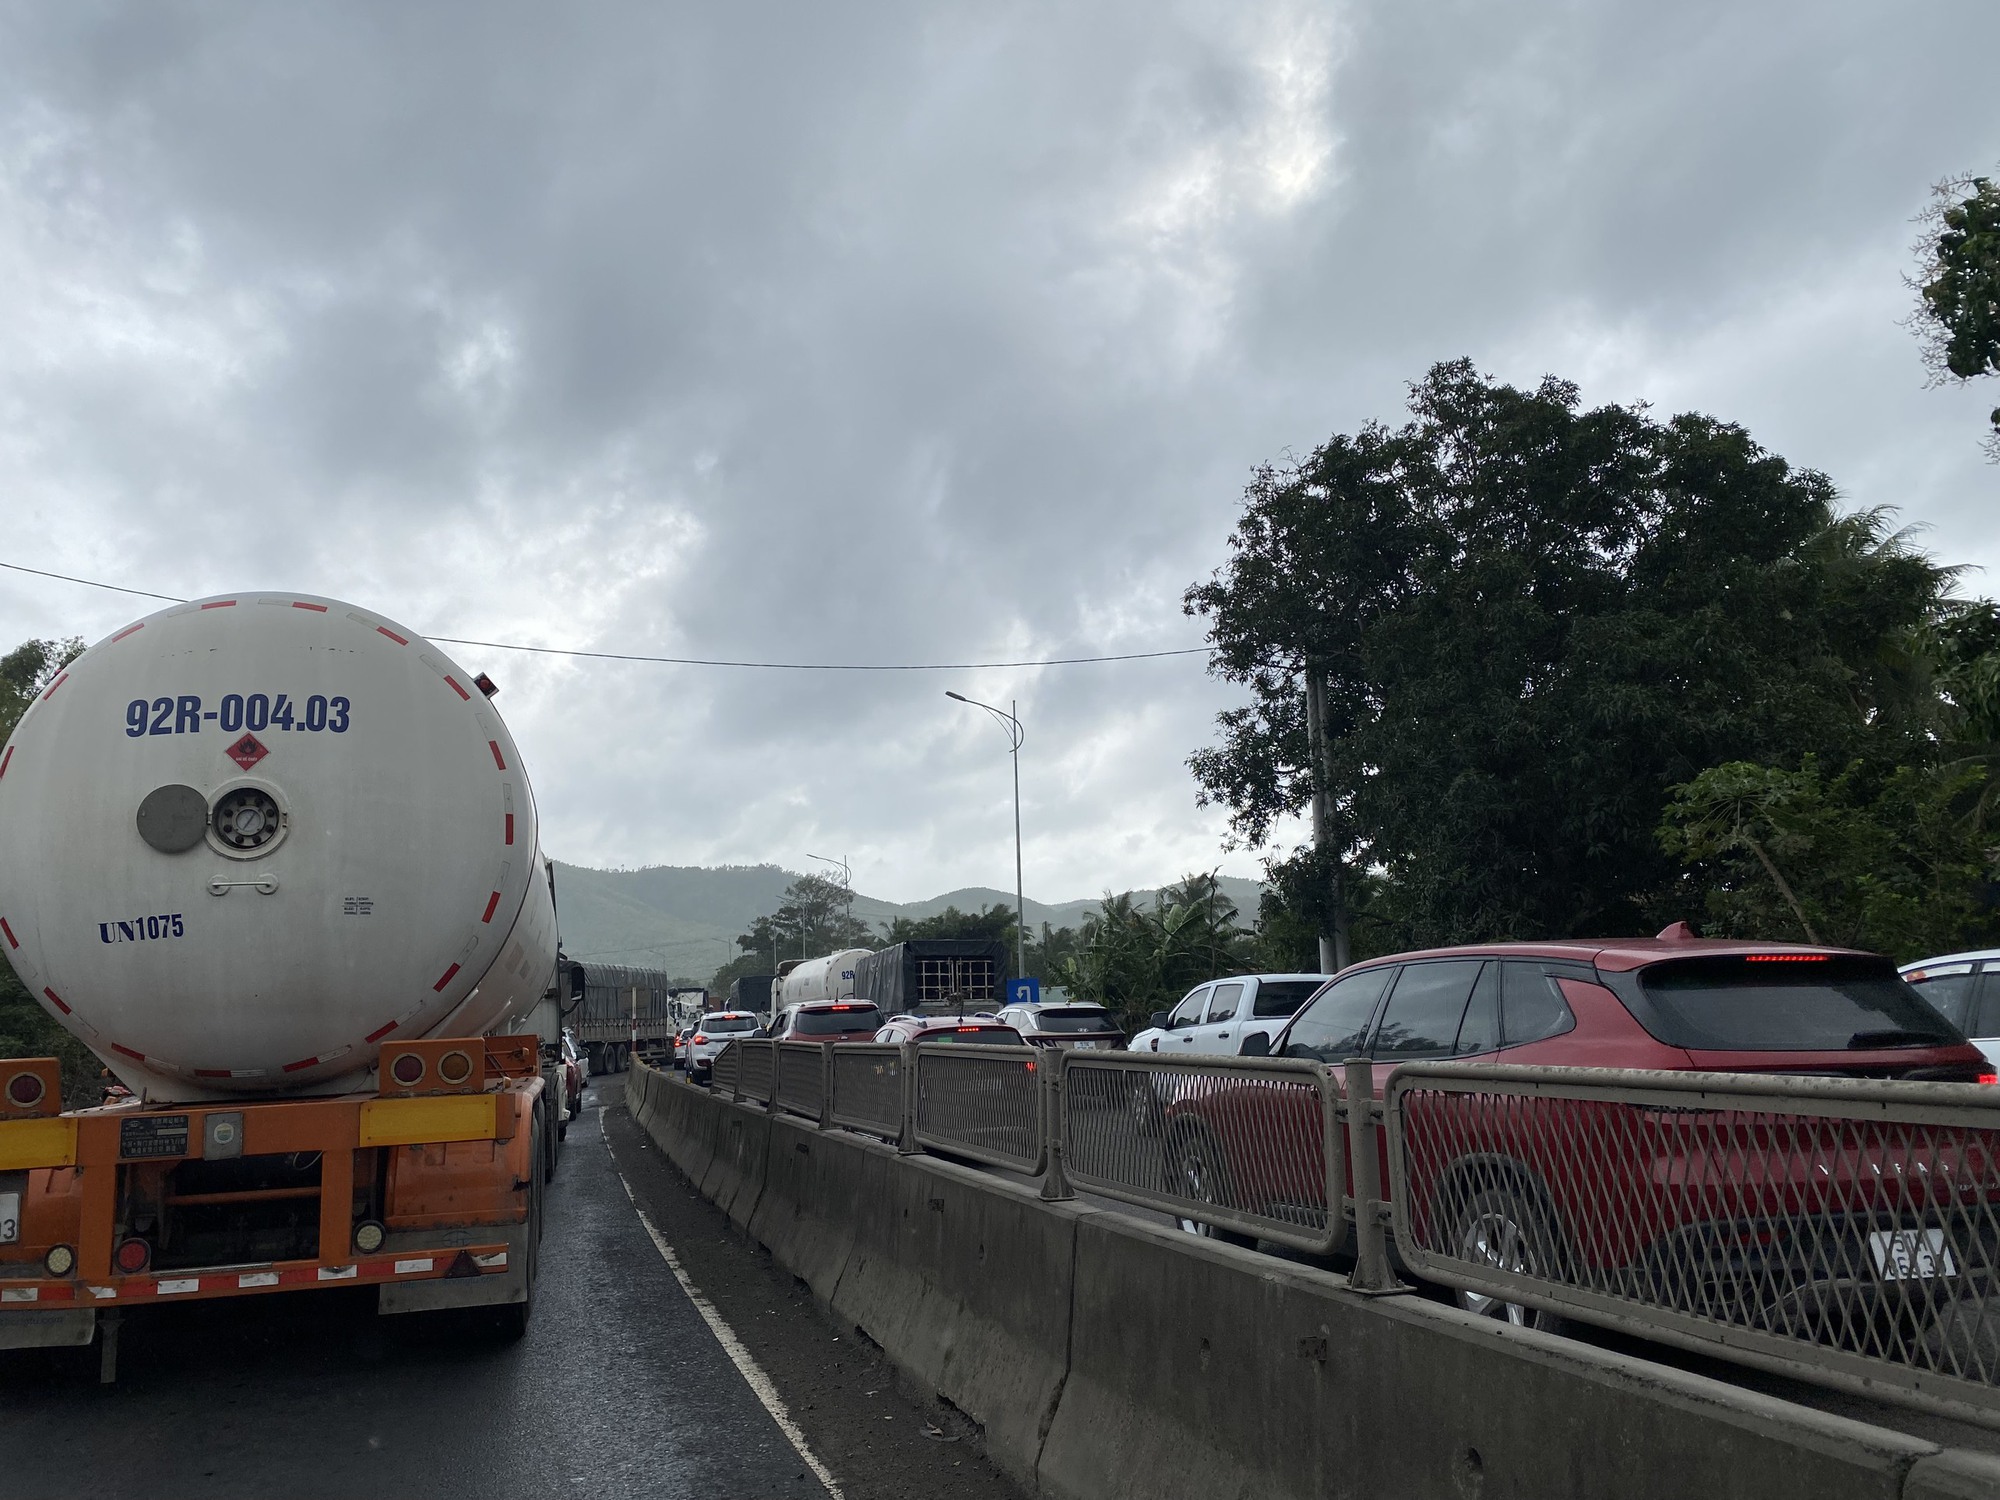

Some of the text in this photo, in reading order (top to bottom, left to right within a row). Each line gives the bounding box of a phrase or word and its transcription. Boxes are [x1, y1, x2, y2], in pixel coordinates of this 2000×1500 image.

[125, 693, 351, 737] 92R-004.03
[98, 914, 184, 943] UN1075
[0, 1218, 16, 1240] 3
